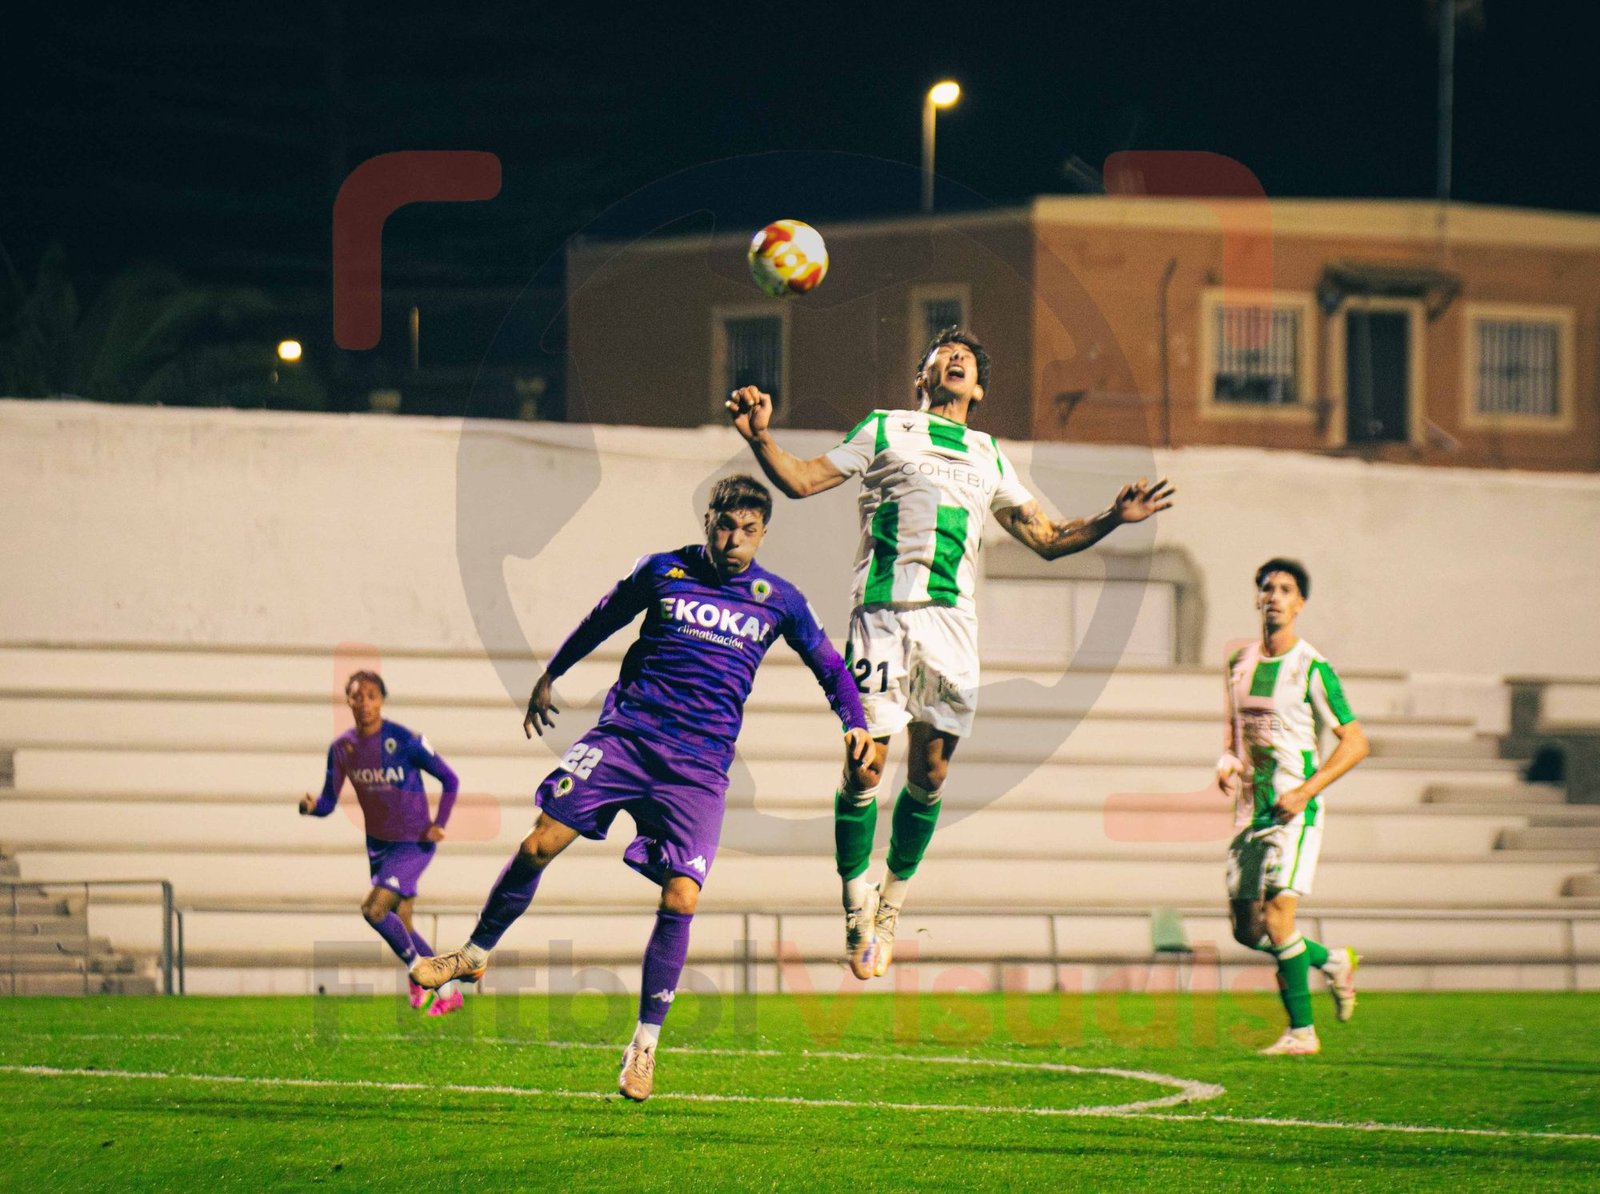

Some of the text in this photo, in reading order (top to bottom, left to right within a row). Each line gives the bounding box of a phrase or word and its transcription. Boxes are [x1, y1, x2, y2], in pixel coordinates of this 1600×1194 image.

[659, 597, 770, 642] EKOKAI
[855, 658, 889, 694] 21
[559, 742, 604, 781] 22
